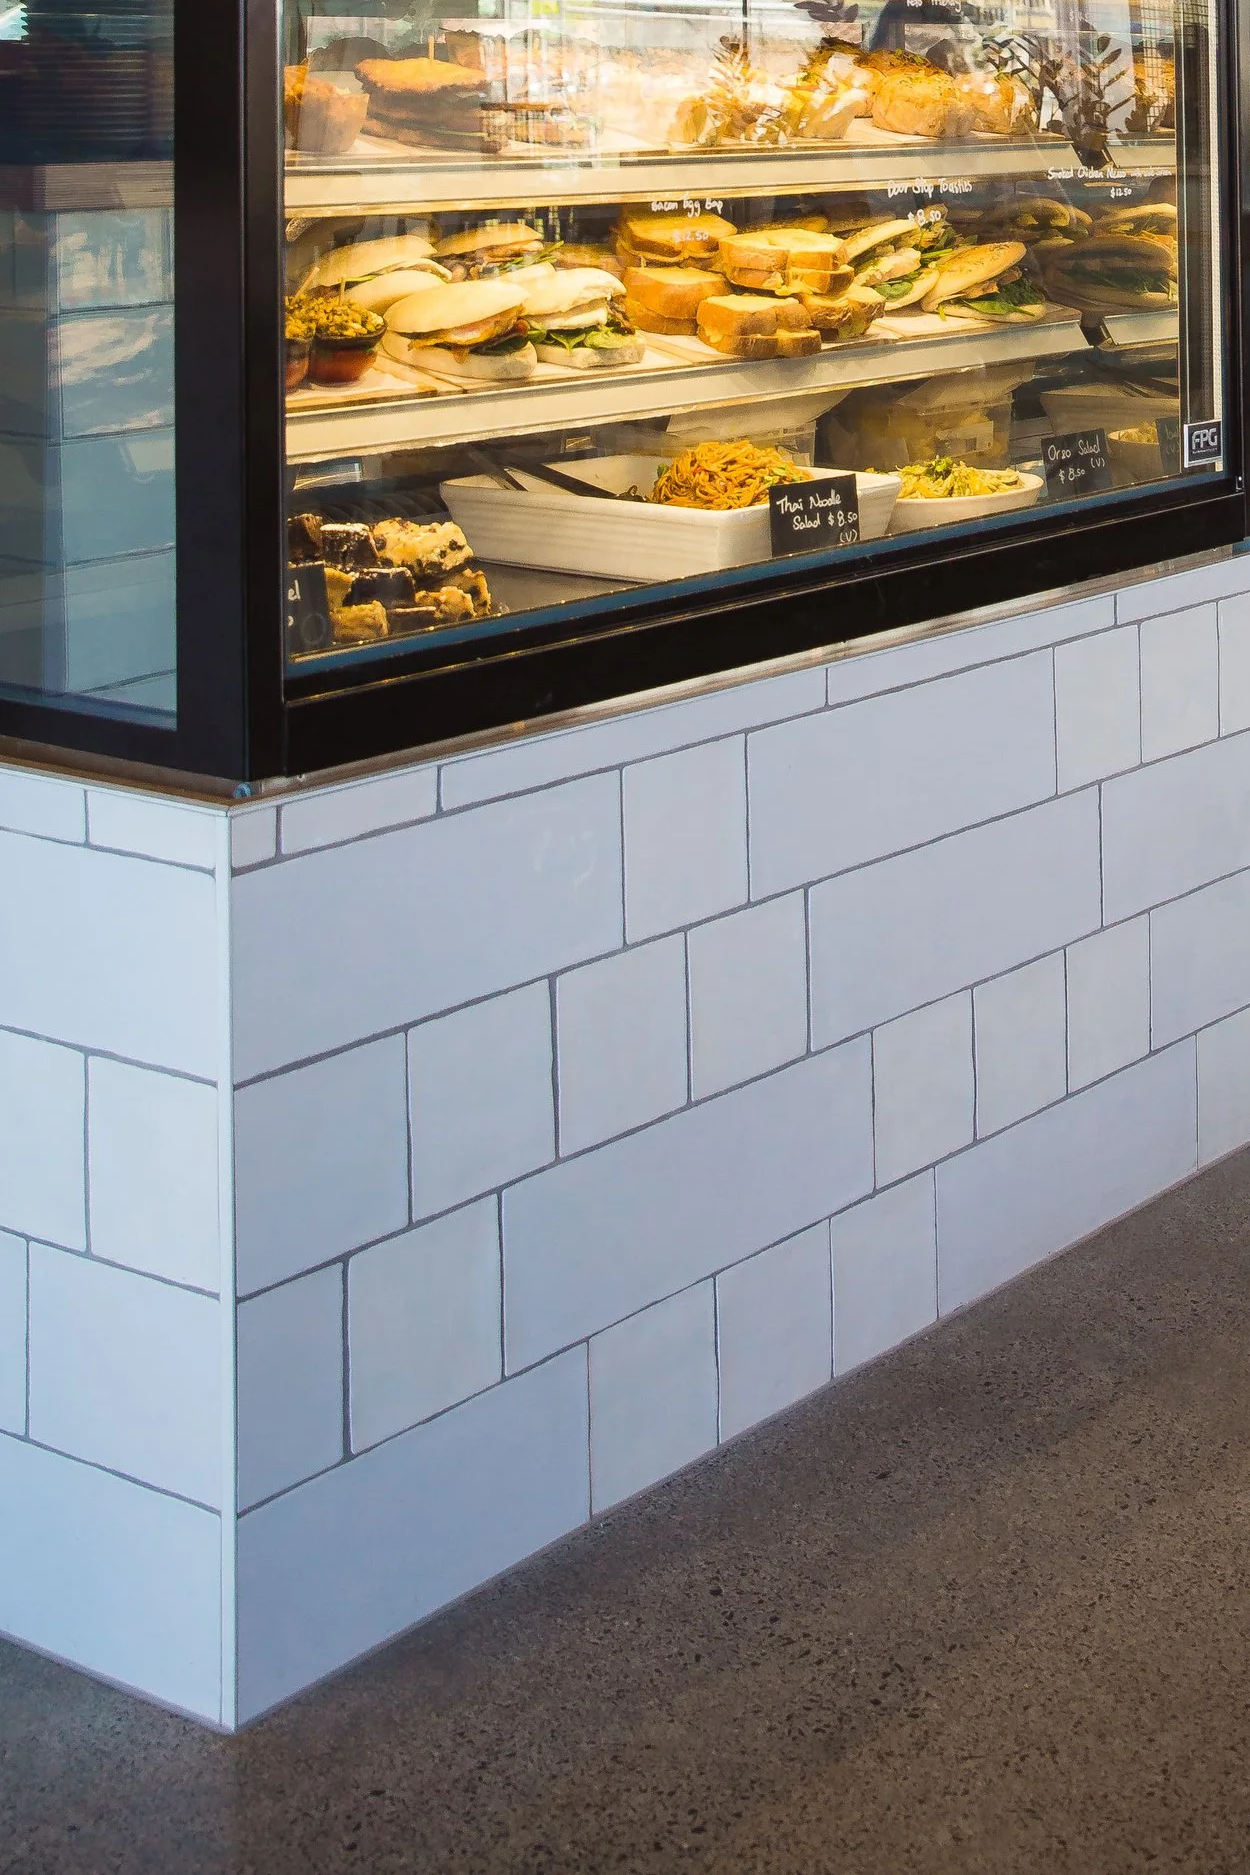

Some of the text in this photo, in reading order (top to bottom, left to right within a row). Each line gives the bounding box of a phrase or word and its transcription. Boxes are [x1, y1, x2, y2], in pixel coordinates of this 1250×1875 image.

[1078, 434, 1101, 456] Salad
[1191, 427, 1218, 451] FPG
[1090, 456, 1106, 469] (V)
[775, 488, 842, 515] Thai Noodle
[793, 512, 820, 530] Salad
[839, 528, 858, 543] (V)
